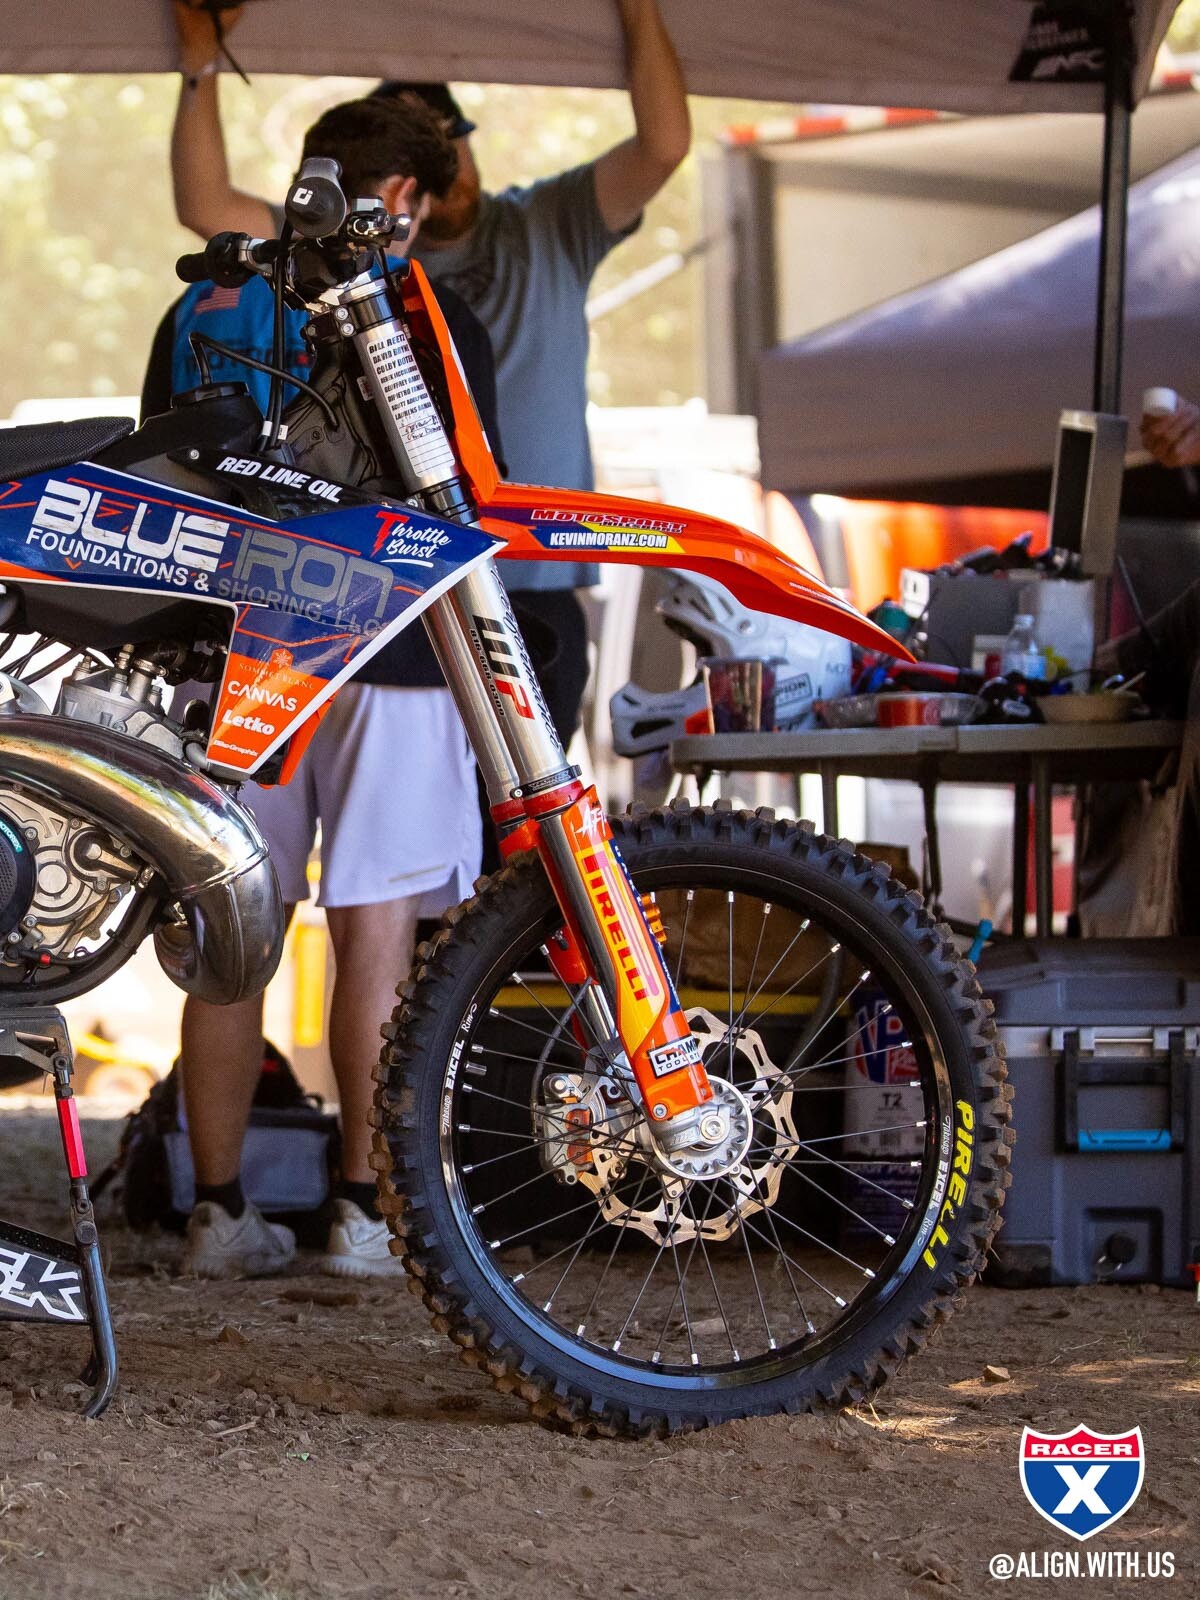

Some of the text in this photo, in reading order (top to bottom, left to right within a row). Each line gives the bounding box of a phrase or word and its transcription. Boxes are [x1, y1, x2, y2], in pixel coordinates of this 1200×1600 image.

[216, 456, 344, 504] RED LINE OIL
[32, 478, 230, 573] BLUE
[371, 511, 452, 558] Throttle
[386, 538, 439, 559] Burst
[550, 532, 668, 548] KEVINMORANZ.COM
[25, 527, 189, 586] FOUNDATIONS
[194, 573, 210, 592] &
[472, 614, 536, 721] WP
[227, 680, 298, 712] CANVAS
[221, 709, 276, 735] Letko
[582, 850, 650, 1001] PIRELLI
[445, 1040, 465, 1090] EXCEL
[461, 1003, 478, 1032] Rim
[923, 1100, 975, 1270] PIRELLI
[928, 1159, 949, 1210] EXCEL
[917, 1218, 934, 1247] Rim
